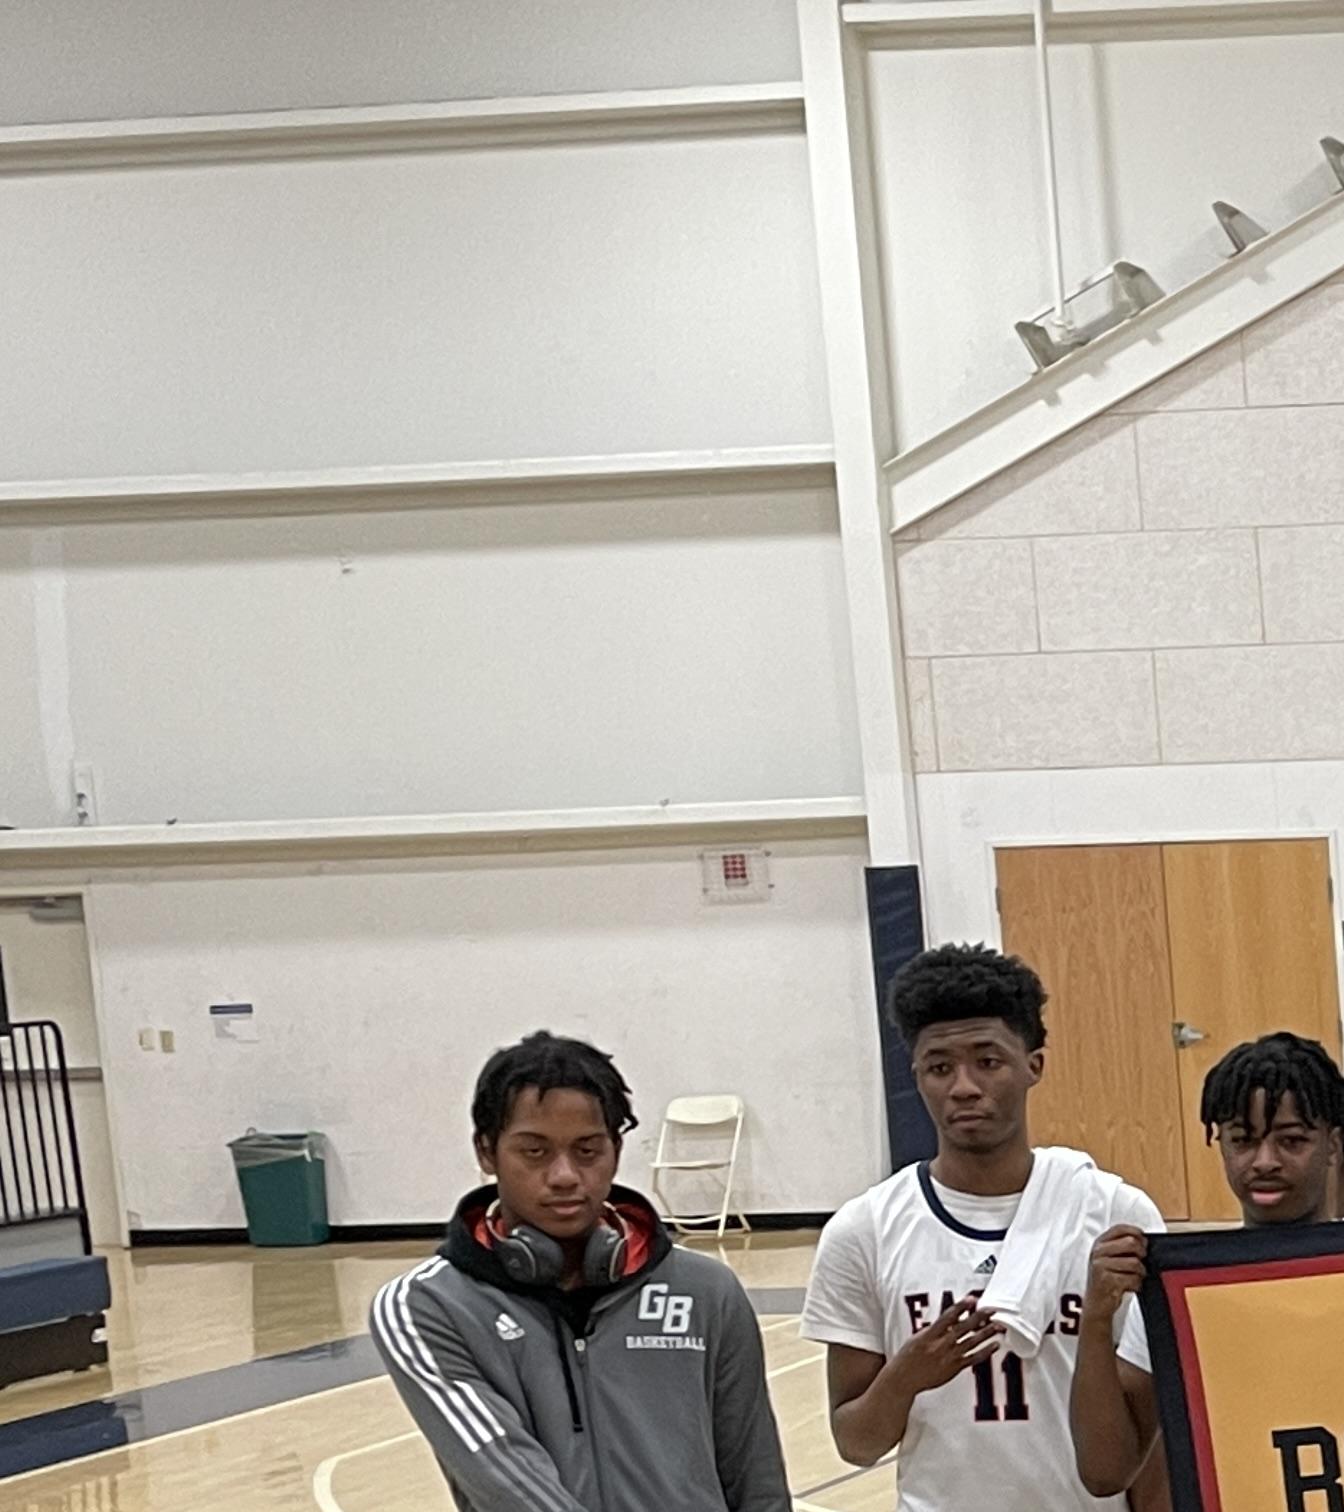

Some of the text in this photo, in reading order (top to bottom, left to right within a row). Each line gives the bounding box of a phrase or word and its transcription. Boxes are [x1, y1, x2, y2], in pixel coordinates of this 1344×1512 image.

[638, 1283, 693, 1334] GB
[626, 1336, 706, 1351] BASKETBALL
[972, 1351, 1029, 1421] 11
